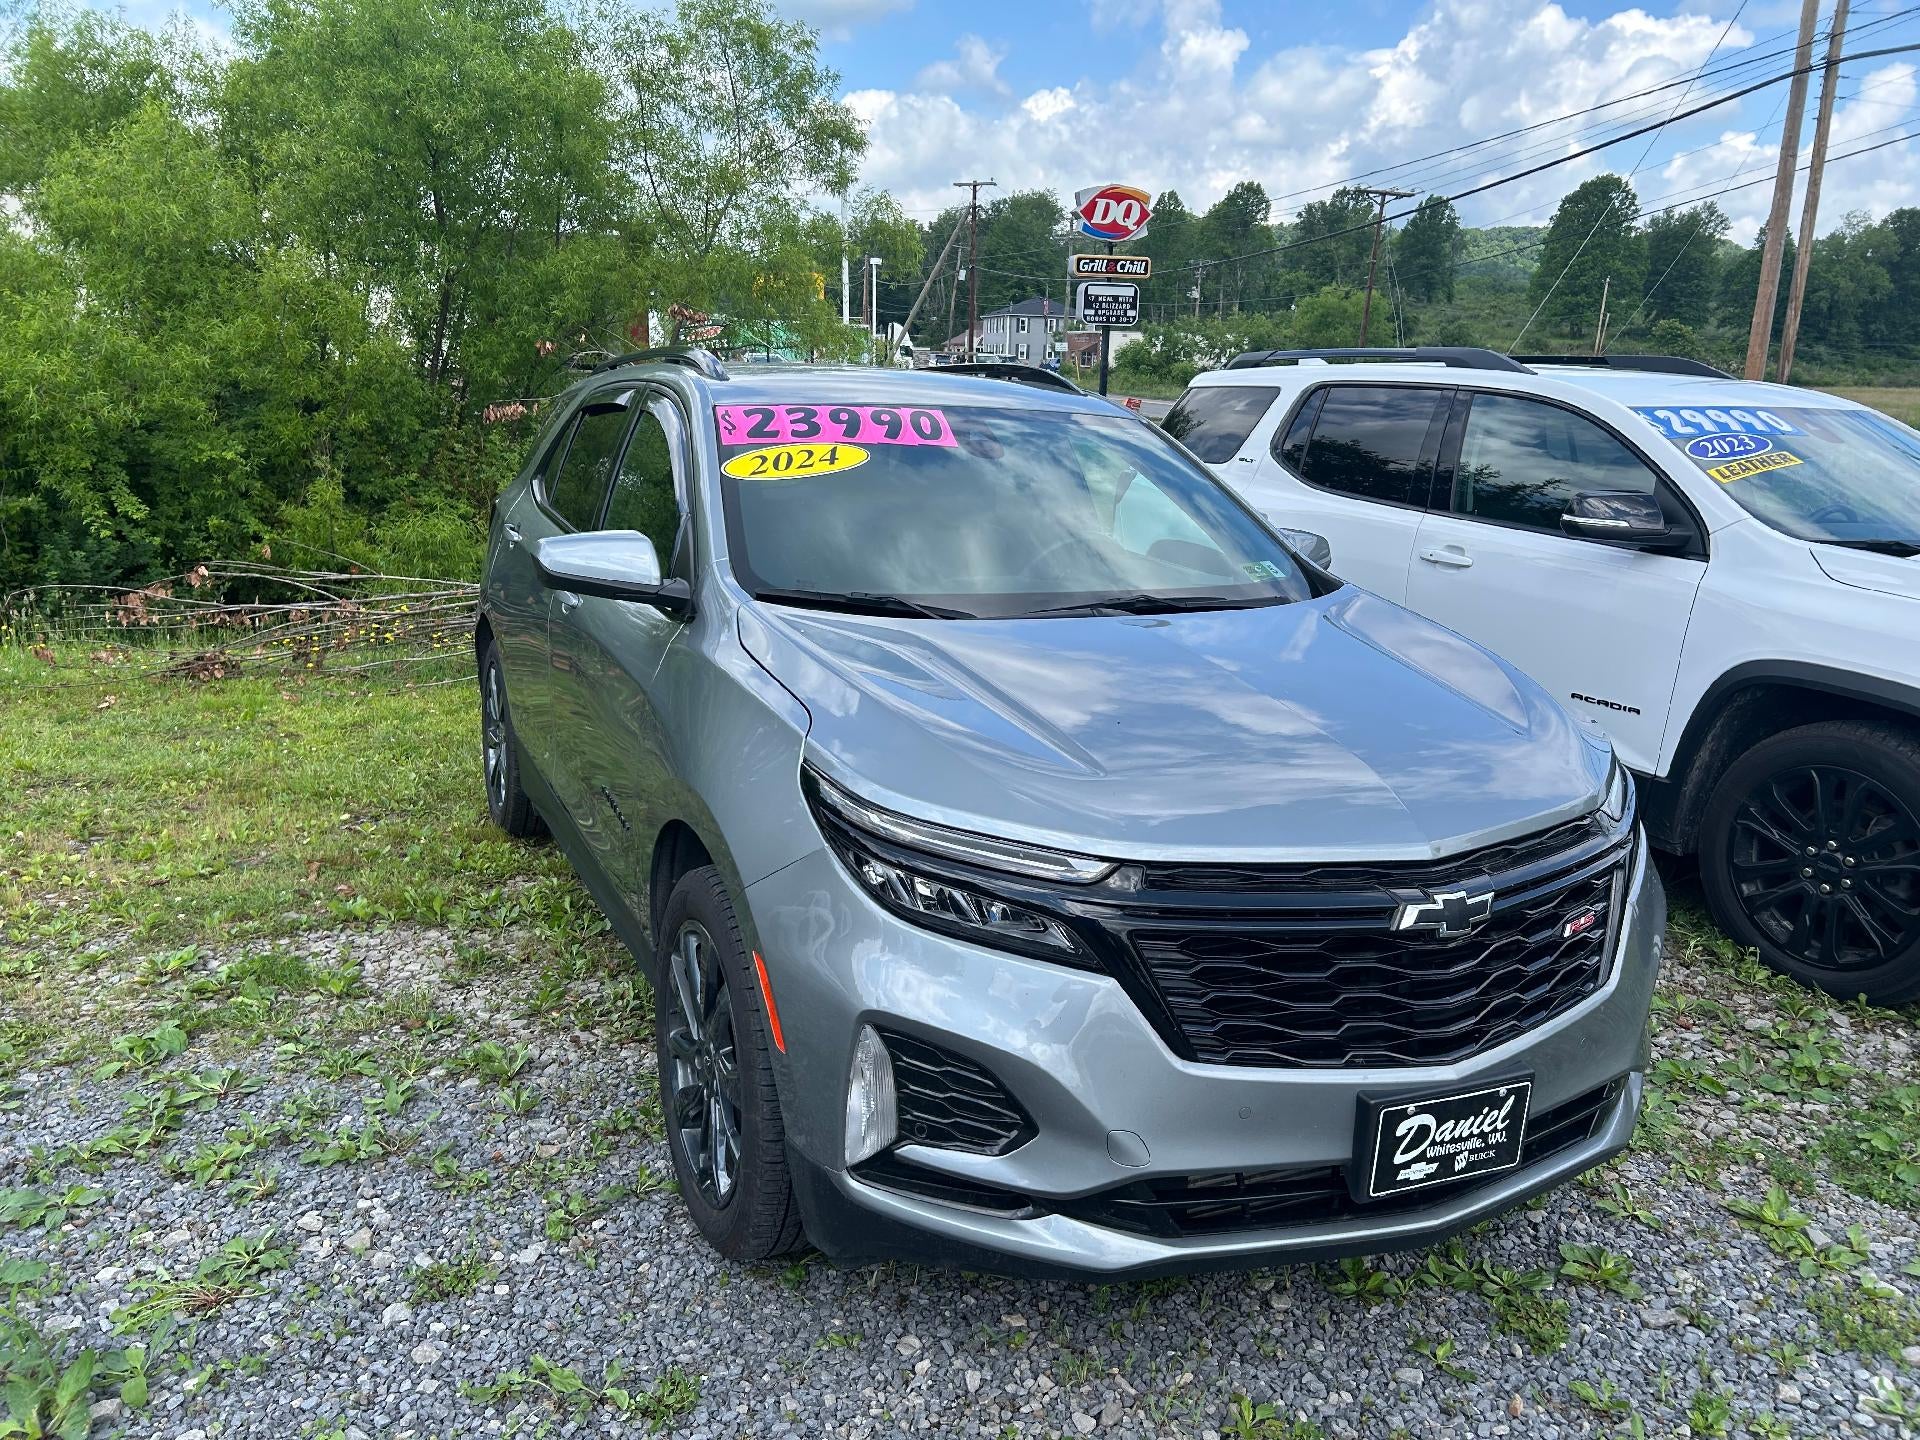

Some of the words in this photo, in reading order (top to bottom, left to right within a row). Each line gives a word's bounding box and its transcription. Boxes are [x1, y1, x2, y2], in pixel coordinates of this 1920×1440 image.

[1090, 198, 1140, 231] DQ
[1079, 259, 1107, 272] Grill
[1107, 261, 1116, 272] &
[1116, 260, 1146, 274] Chill
[721, 407, 942, 440] $23990
[1699, 436, 1756, 458] 2023
[749, 446, 839, 476] 2024
[1715, 452, 1793, 479] LEATHER
[1570, 692, 1641, 716] ACADIA
[1563, 911, 1596, 938] RS
[1393, 1094, 1516, 1165] Daniel
[1468, 1149, 1496, 1162] BUICK
